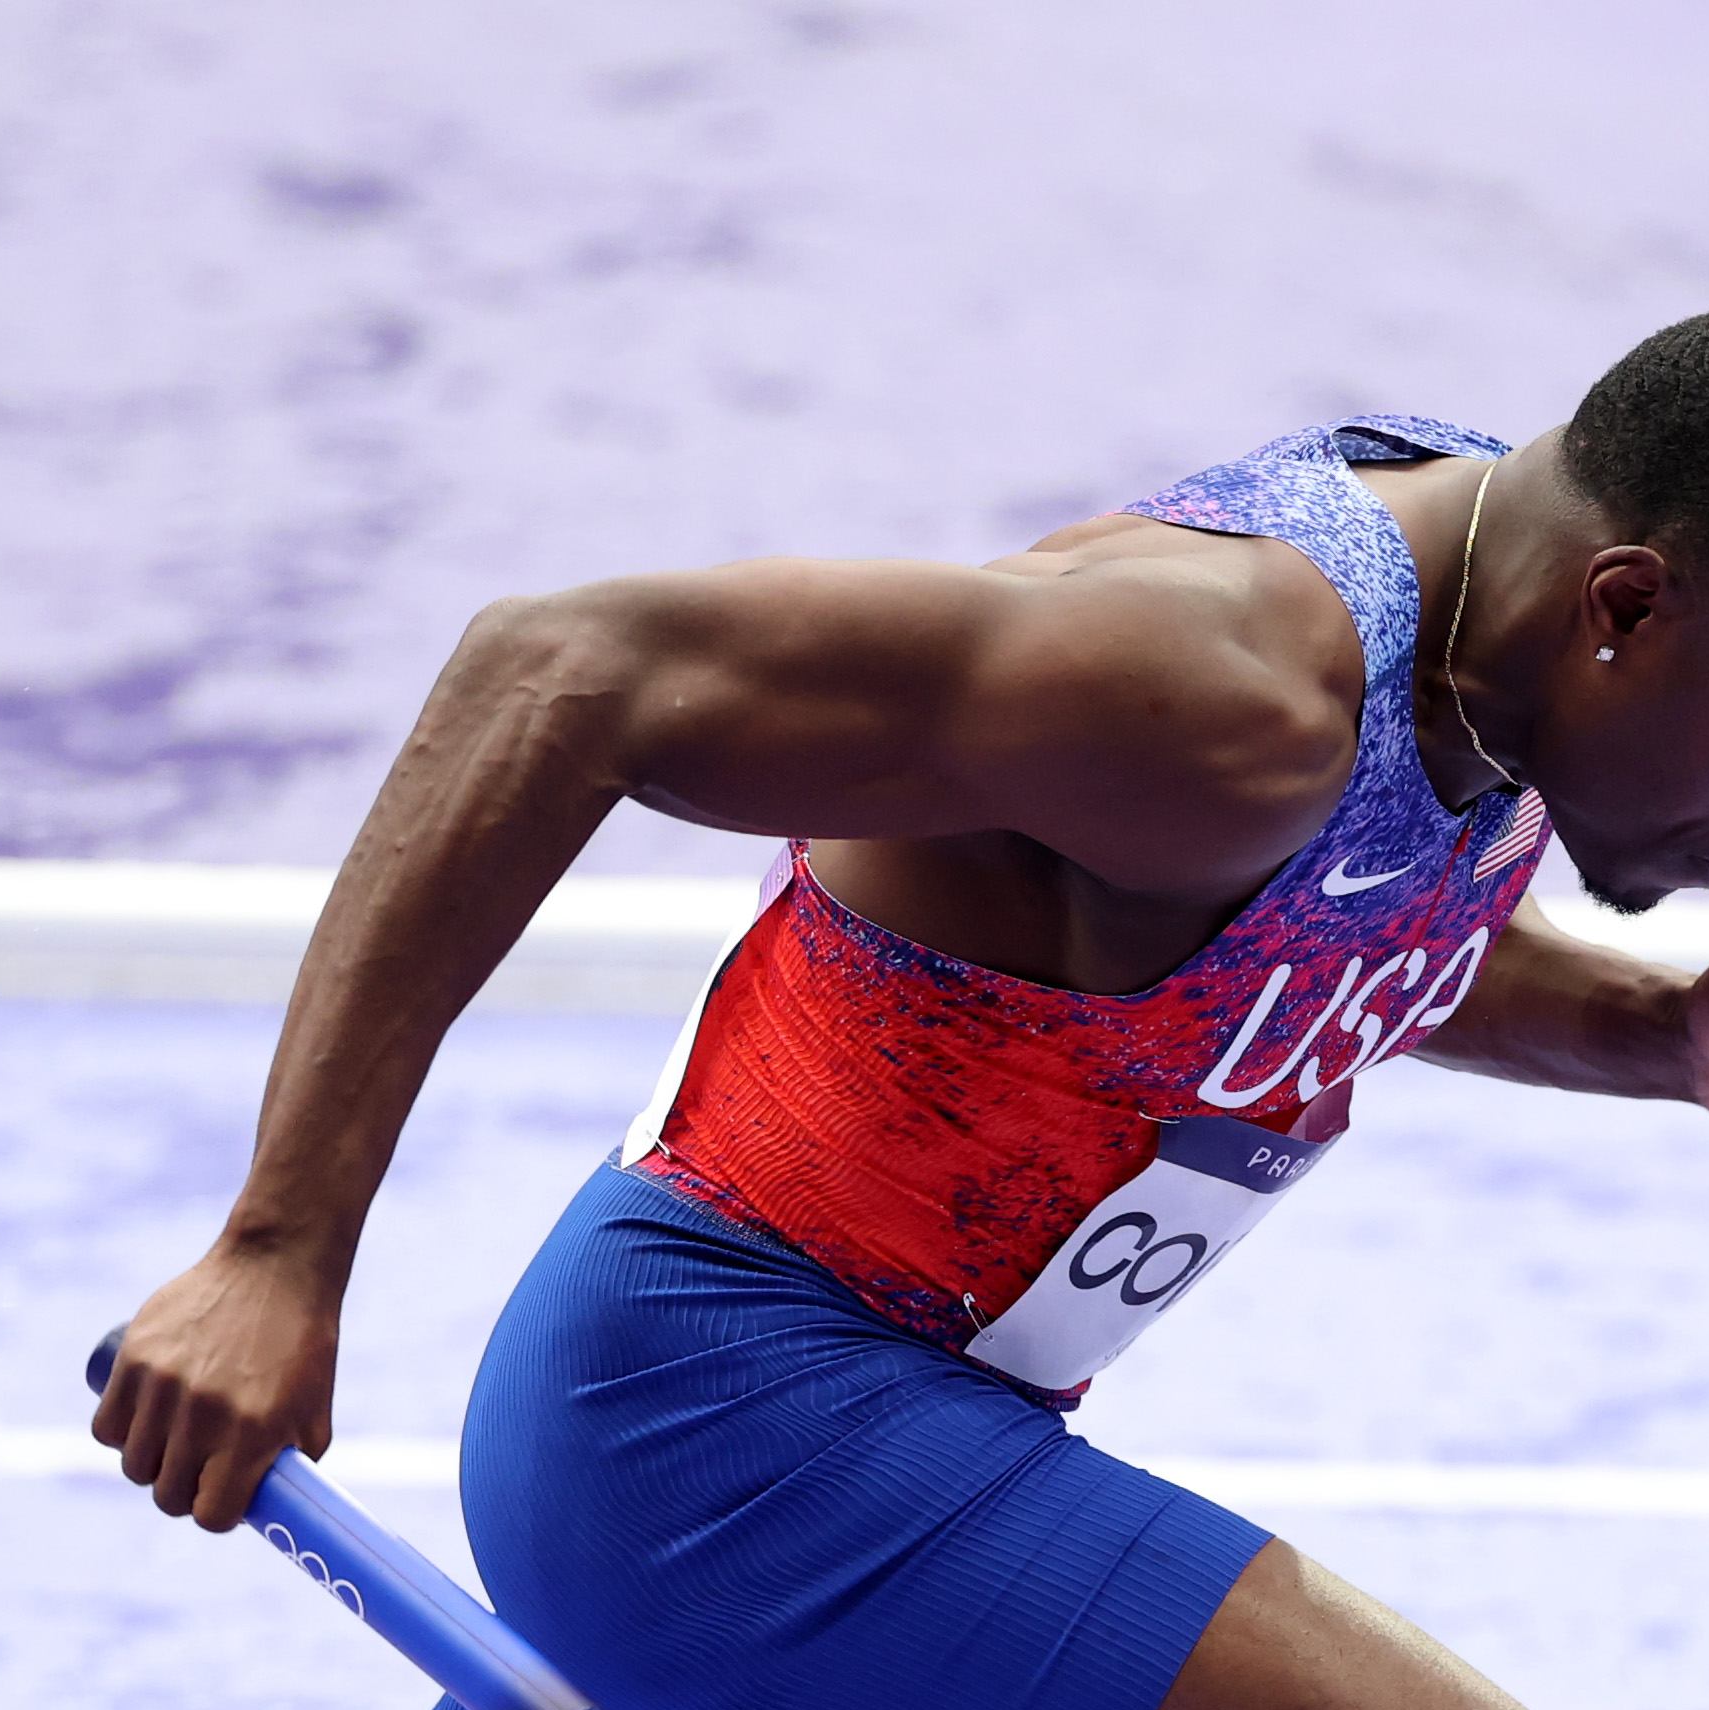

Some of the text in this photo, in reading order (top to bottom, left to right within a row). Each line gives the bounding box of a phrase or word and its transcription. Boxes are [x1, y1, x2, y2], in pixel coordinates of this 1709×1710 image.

[1197, 926, 1489, 1109] USA
[1247, 1146, 1315, 1179] PAR
[1069, 1211, 1231, 1313] CO
